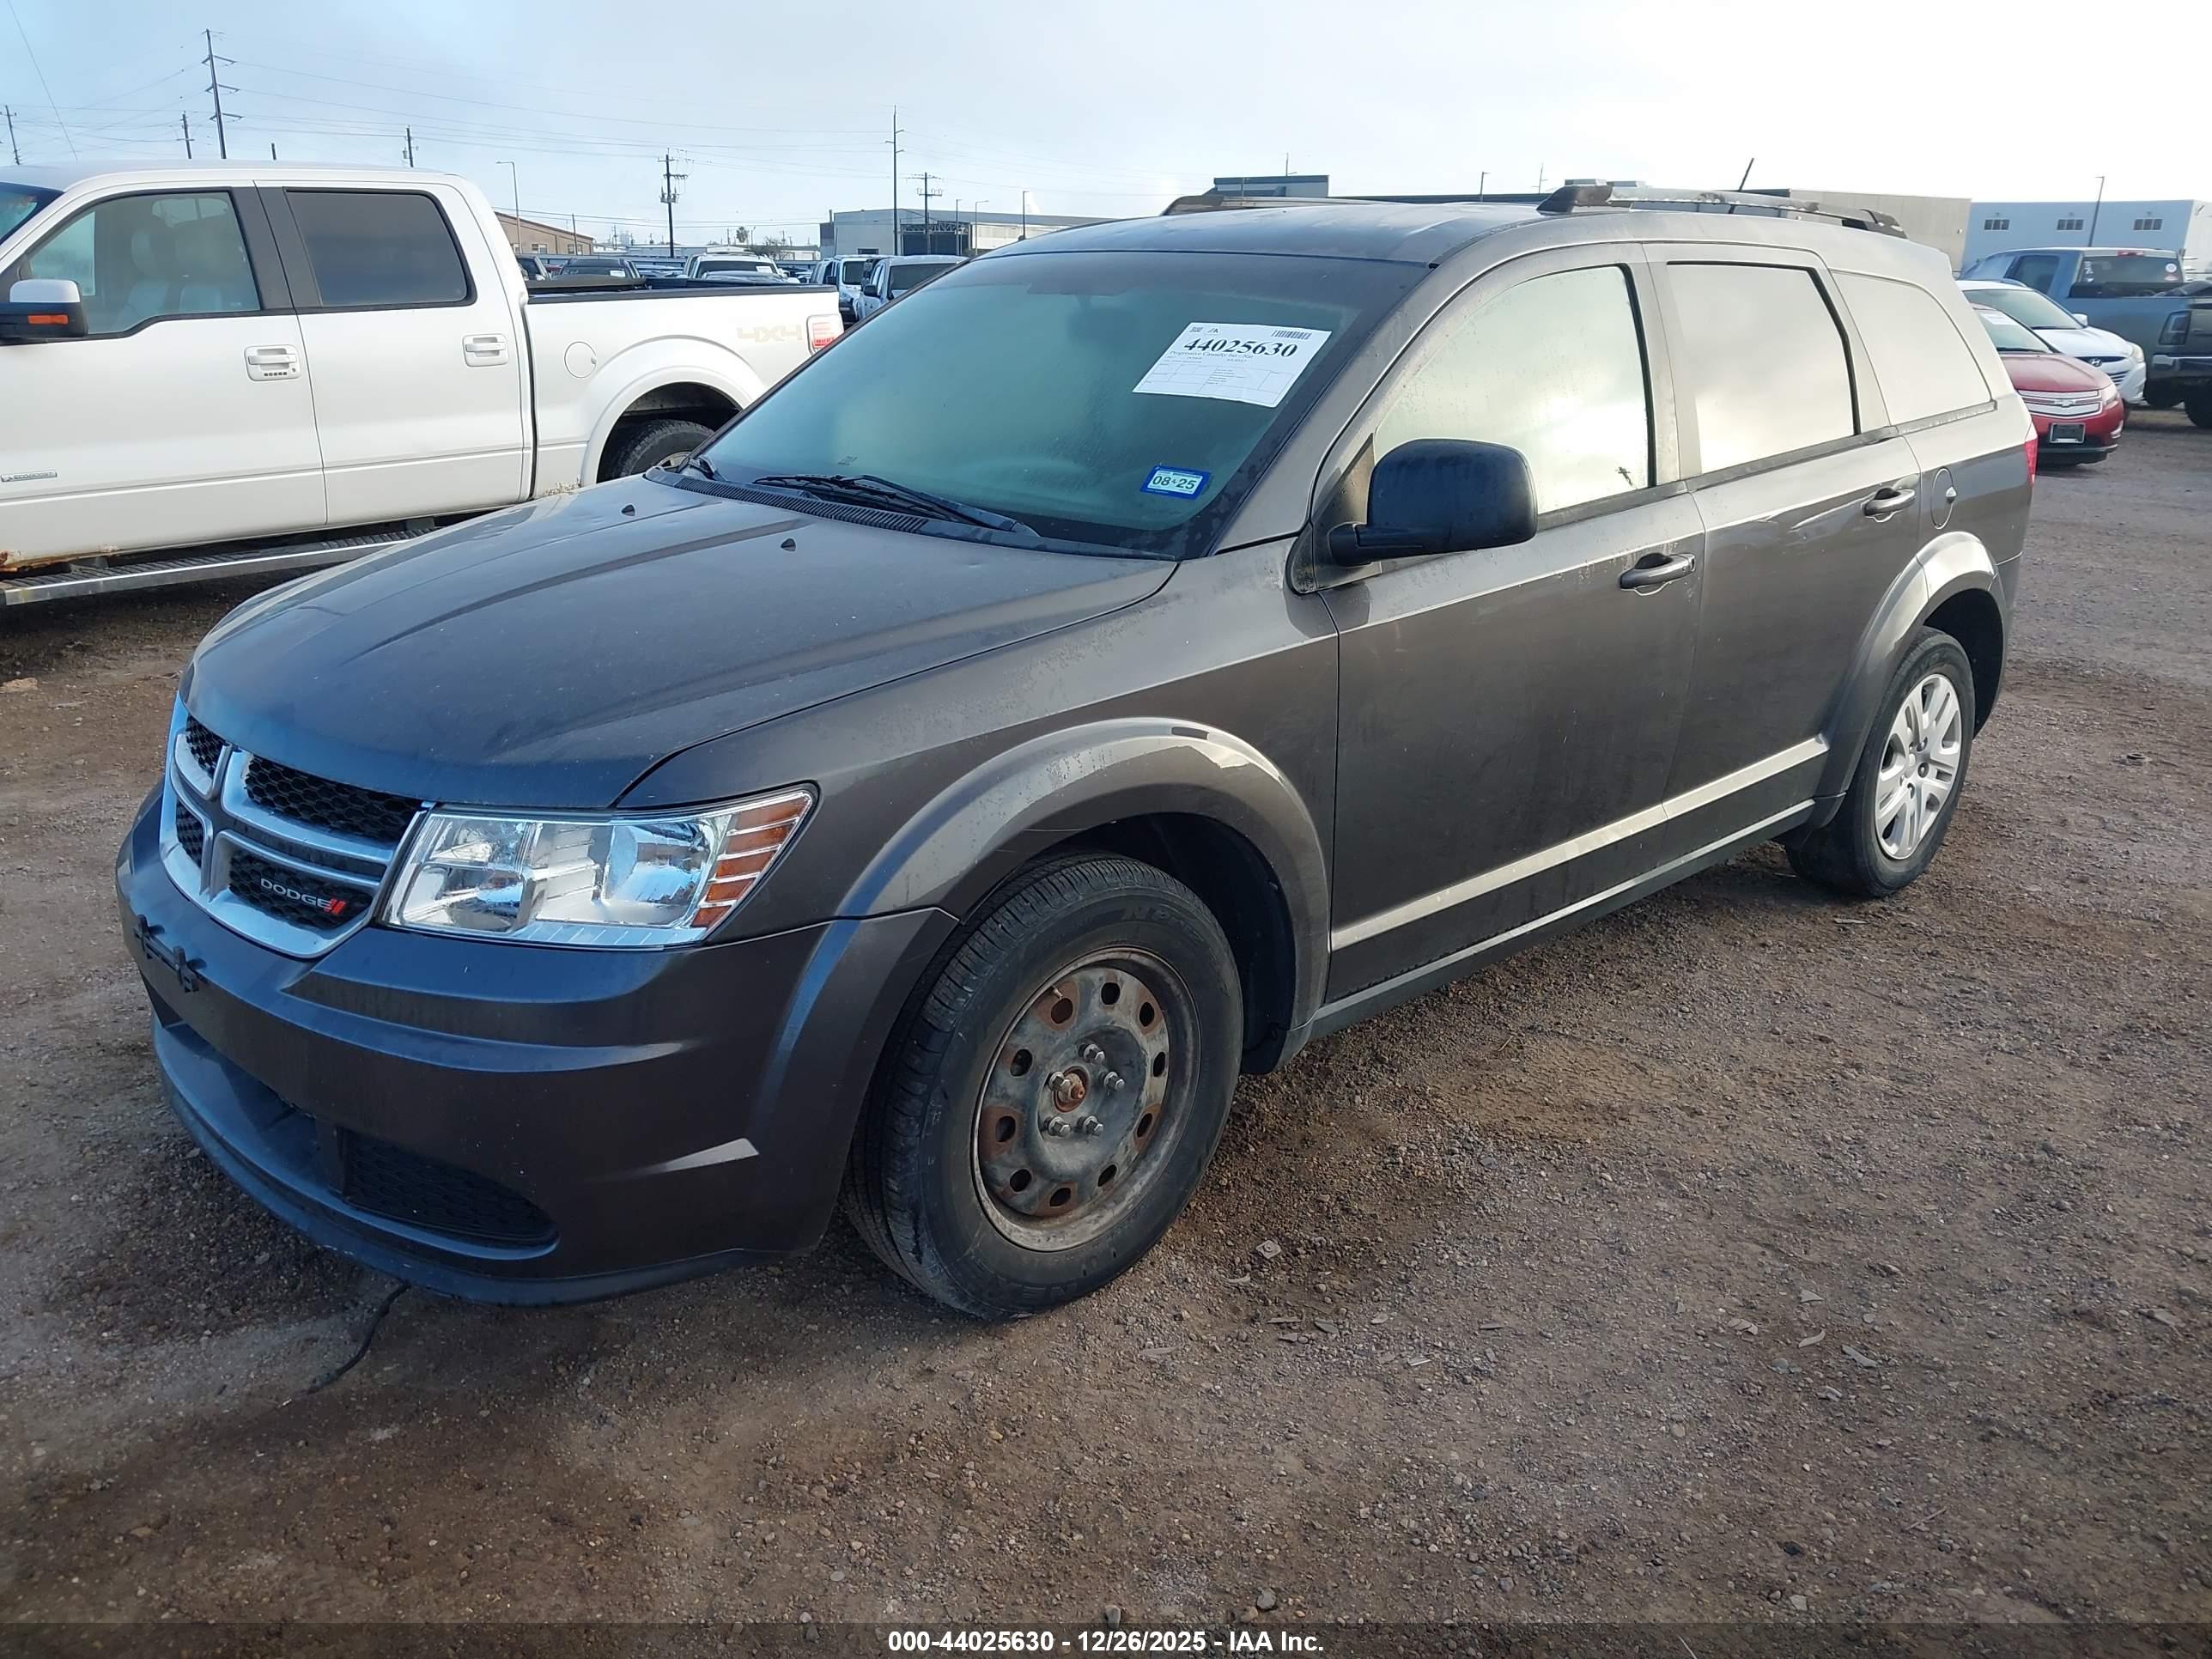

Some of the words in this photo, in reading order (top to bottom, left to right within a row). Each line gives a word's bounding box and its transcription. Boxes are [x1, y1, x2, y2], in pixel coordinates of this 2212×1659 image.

[1184, 337, 1298, 358] 44025630
[1152, 476, 1171, 486] 08
[1176, 478, 1197, 489] 25
[260, 878, 332, 910] DODGE
